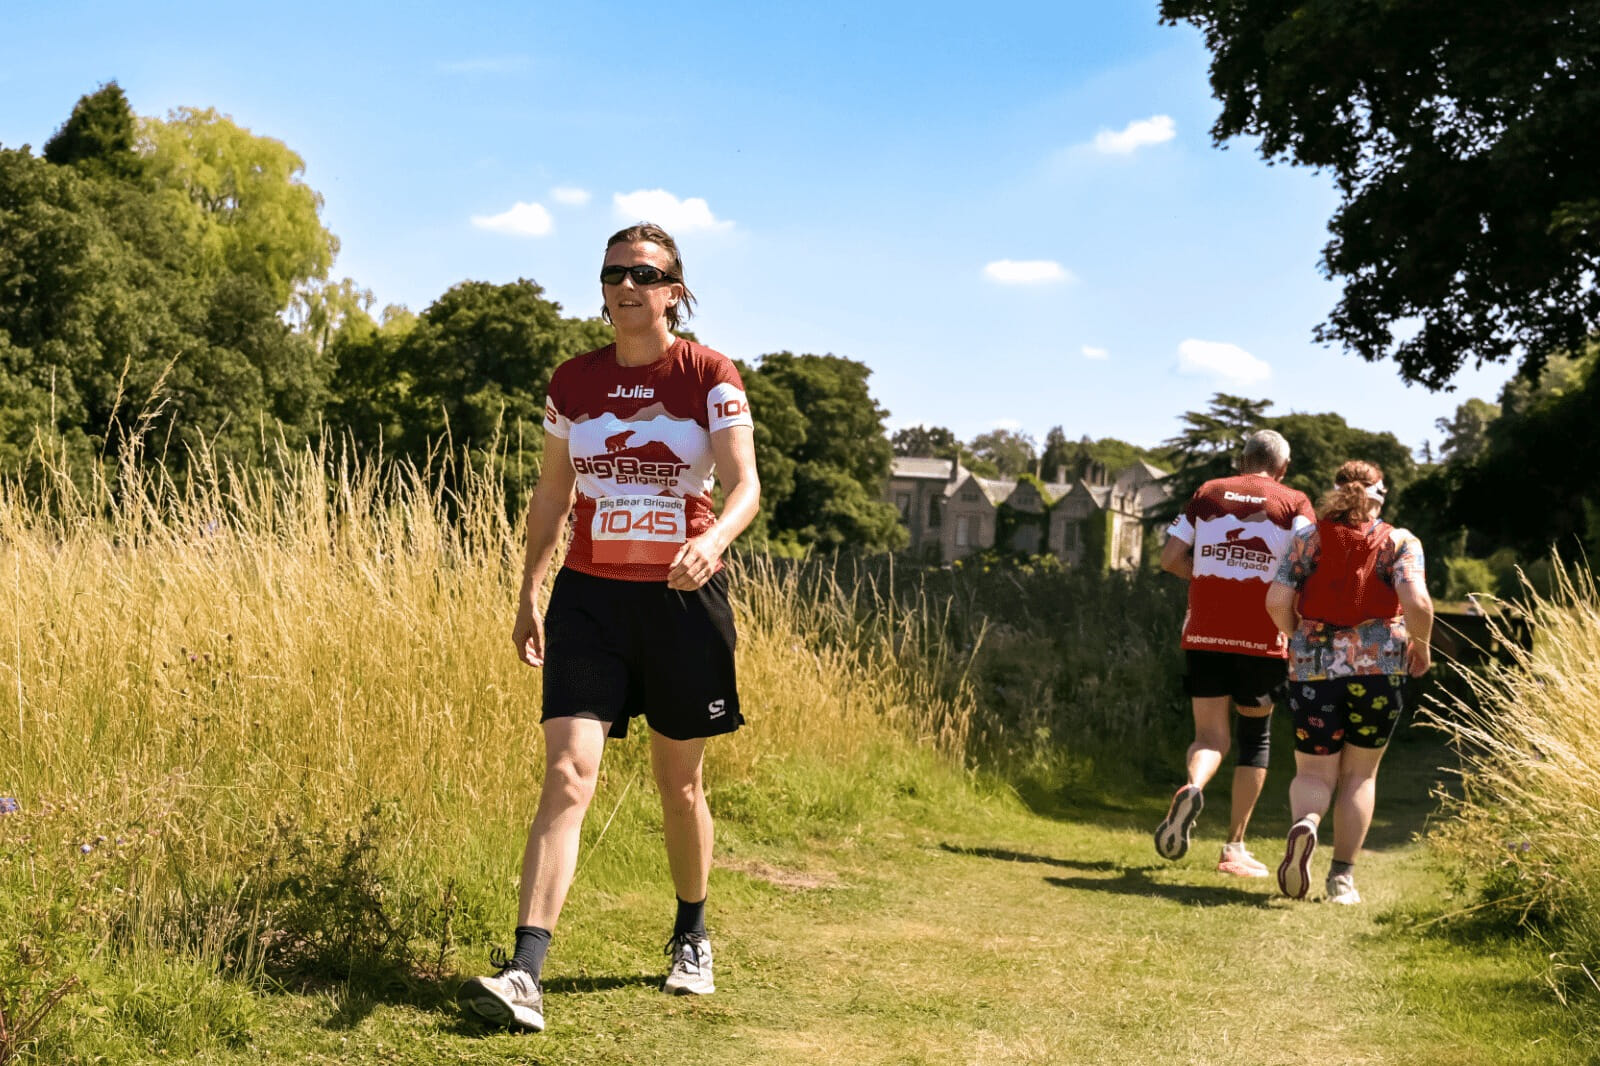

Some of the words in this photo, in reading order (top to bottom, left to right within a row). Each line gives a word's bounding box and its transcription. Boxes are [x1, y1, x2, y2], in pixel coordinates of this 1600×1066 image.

[607, 385, 655, 398] Julia
[573, 457, 616, 479] Big
[617, 458, 691, 478] Bear
[615, 474, 678, 487] Brigade
[1224, 491, 1267, 504] Dieter
[600, 500, 615, 510] Big
[616, 498, 640, 506] Bear
[643, 498, 683, 511] Brigade
[600, 510, 678, 535] 1045
[1201, 545, 1229, 561] Big
[1230, 547, 1277, 564] Bear
[1226, 559, 1269, 572] Brigade
